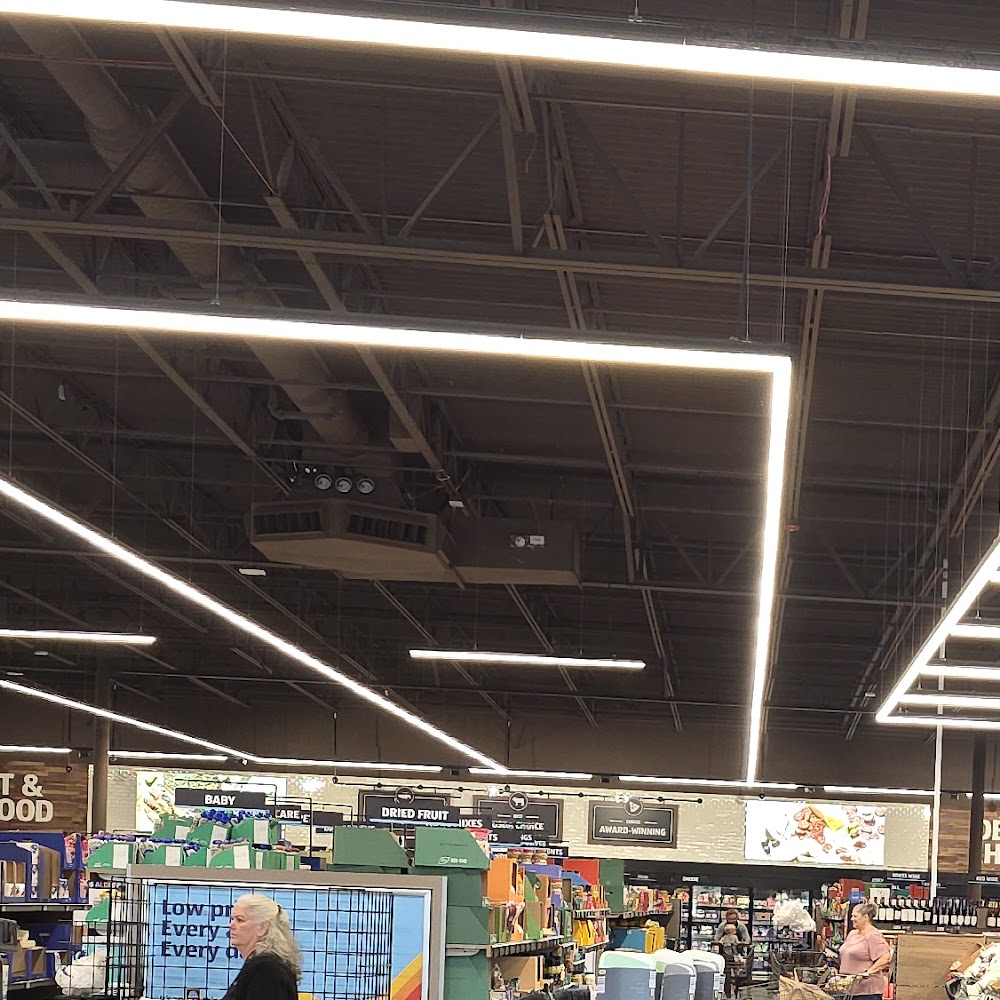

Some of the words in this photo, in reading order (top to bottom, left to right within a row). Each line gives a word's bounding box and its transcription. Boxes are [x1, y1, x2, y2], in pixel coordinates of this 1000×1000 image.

[22, 773, 43, 798] &
[204, 794, 236, 806] BABY
[381, 806, 415, 819] DRIED
[417, 809, 449, 821] FRUIT
[599, 826, 666, 837] AWARD-WINNING
[162, 899, 204, 916] Low
[161, 920, 220, 942] Every
[161, 941, 220, 963] Every
